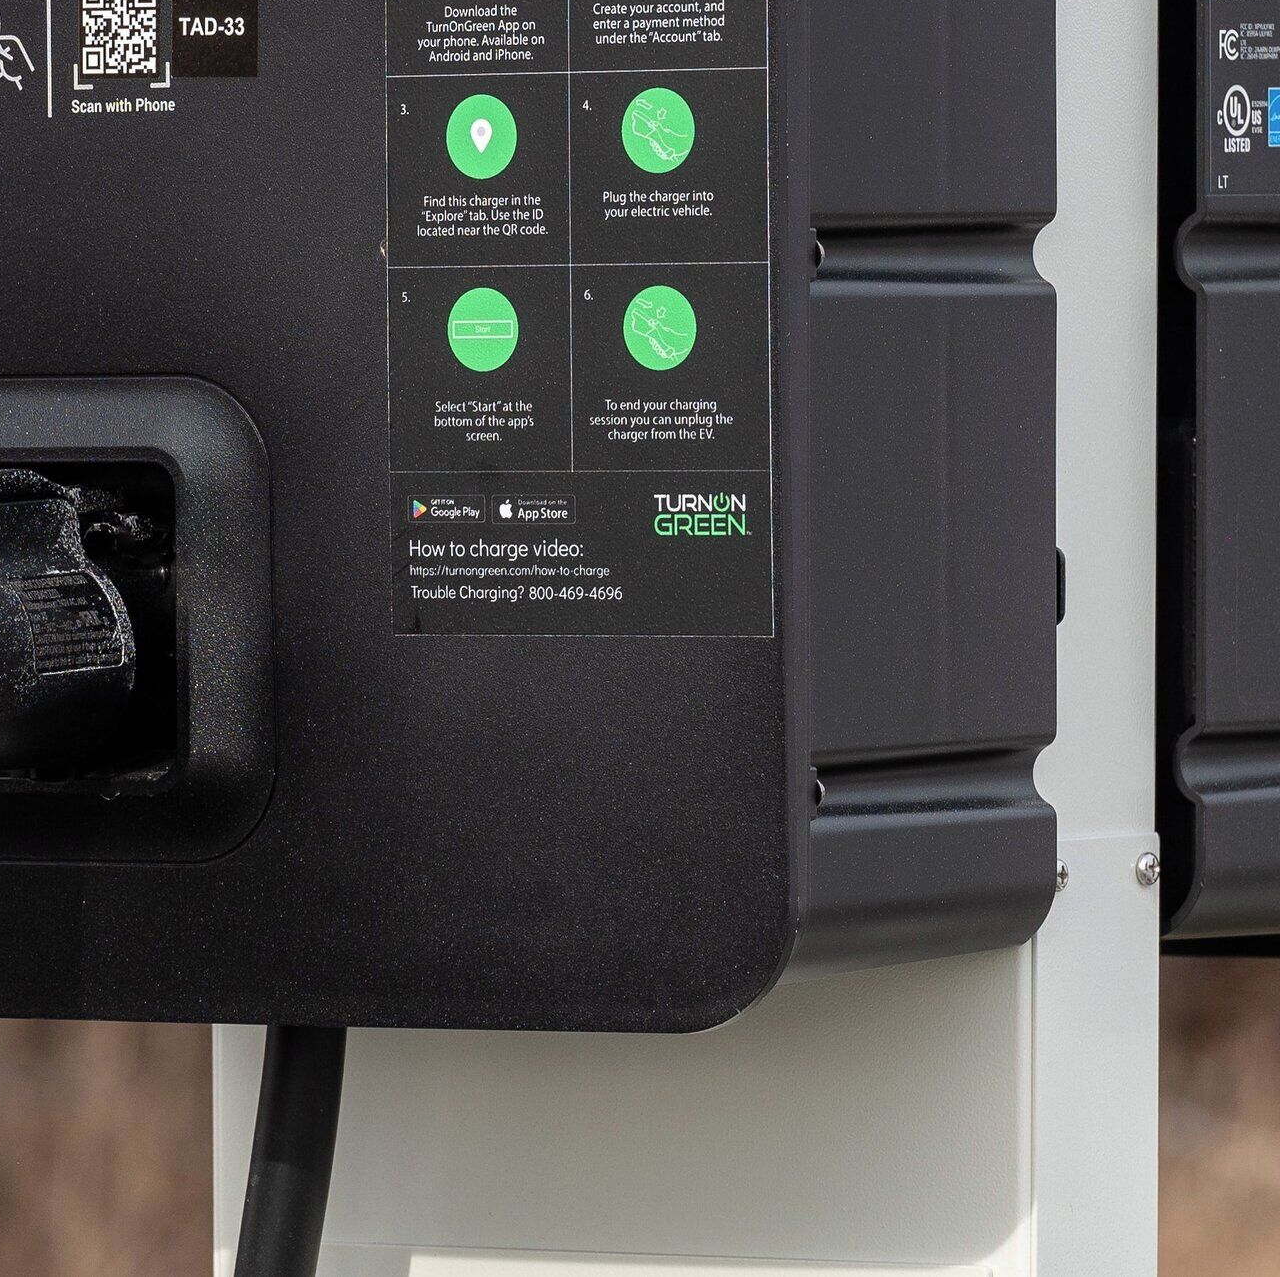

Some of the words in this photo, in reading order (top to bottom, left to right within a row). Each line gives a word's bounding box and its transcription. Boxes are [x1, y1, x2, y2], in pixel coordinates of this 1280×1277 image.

[444, 5, 498, 18] Download
[500, 5, 517, 17] the
[593, 2, 627, 15] Create
[629, 3, 654, 18] your
[656, 1, 702, 15] account,
[704, 0, 725, 12] and
[178, 16, 245, 37] TAD-33
[426, 20, 495, 33] TurnOnGreen
[498, 19, 520, 35] App
[522, 21, 536, 31] on
[593, 17, 620, 30] enter
[623, 19, 630, 29] a
[632, 16, 679, 31] payment
[682, 15, 725, 28] method
[417, 37, 441, 51] your
[443, 34, 479, 50] phone.
[481, 34, 528, 47] Available
[531, 34, 545, 45] on
[595, 32, 626, 45] under
[629, 31, 648, 43] the
[703, 30, 723, 43] tab.
[429, 49, 470, 62] Android
[472, 49, 492, 61] and
[495, 48, 534, 61] iPhone.
[71, 98, 103, 114] Scan
[105, 97, 132, 113] with
[135, 97, 176, 113] Phone
[400, 104, 409, 116] 3.
[582, 99, 592, 111] 4.
[1229, 96, 1244, 125] UL
[1251, 109, 1262, 125] US
[1224, 137, 1251, 153] LISTED
[1217, 175, 1229, 189] LT
[423, 195, 447, 208] Find
[448, 195, 467, 207] this
[469, 195, 509, 210] charger
[511, 195, 521, 206] in
[523, 194, 541, 206] the
[603, 191, 626, 206] Plug
[628, 191, 647, 203] the
[649, 190, 690, 206] charger
[692, 190, 714, 202] into
[469, 210, 489, 222] tab.
[491, 209, 510, 221] Use
[512, 209, 530, 221] the
[532, 209, 544, 220] ID
[604, 206, 629, 219] your
[631, 204, 669, 218] electric
[671, 204, 712, 217] vehicle.
[417, 224, 455, 238] located
[457, 225, 480, 236] near
[482, 224, 500, 236] the
[502, 224, 518, 237] QR
[520, 223, 549, 235] code.
[401, 292, 411, 303] 5.
[584, 289, 594, 301] 6.
[435, 400, 466, 413] Select
[502, 401, 513, 413] at
[515, 400, 533, 412] the
[605, 399, 617, 411] To
[619, 399, 640, 411] end
[642, 401, 667, 414] your
[669, 398, 717, 414] charging
[434, 415, 473, 428] bottom
[475, 415, 486, 427] of
[488, 415, 505, 427] the
[589, 414, 629, 426] session
[630, 415, 652, 428] you
[653, 414, 673, 425] can
[674, 413, 714, 428] unplug
[715, 413, 733, 425] the
[466, 430, 502, 442] screen.
[608, 429, 649, 444] charger
[650, 428, 676, 441] from
[679, 428, 696, 440] the
[699, 428, 715, 439] EV.
[653, 491, 746, 513] TURNON
[430, 506, 462, 519] Google
[462, 506, 480, 519] Play
[517, 507, 538, 522] App
[540, 507, 568, 519] Store
[653, 513, 746, 536] GREEN
[409, 540, 446, 558] How
[449, 541, 465, 557] to
[469, 539, 528, 561] charge
[532, 538, 584, 558] video:
[409, 564, 610, 580] https://turnongreen.com/how-to-charge
[410, 585, 456, 600] Trouble
[459, 584, 525, 603] Charging?
[528, 586, 623, 601] 800-469-4696
